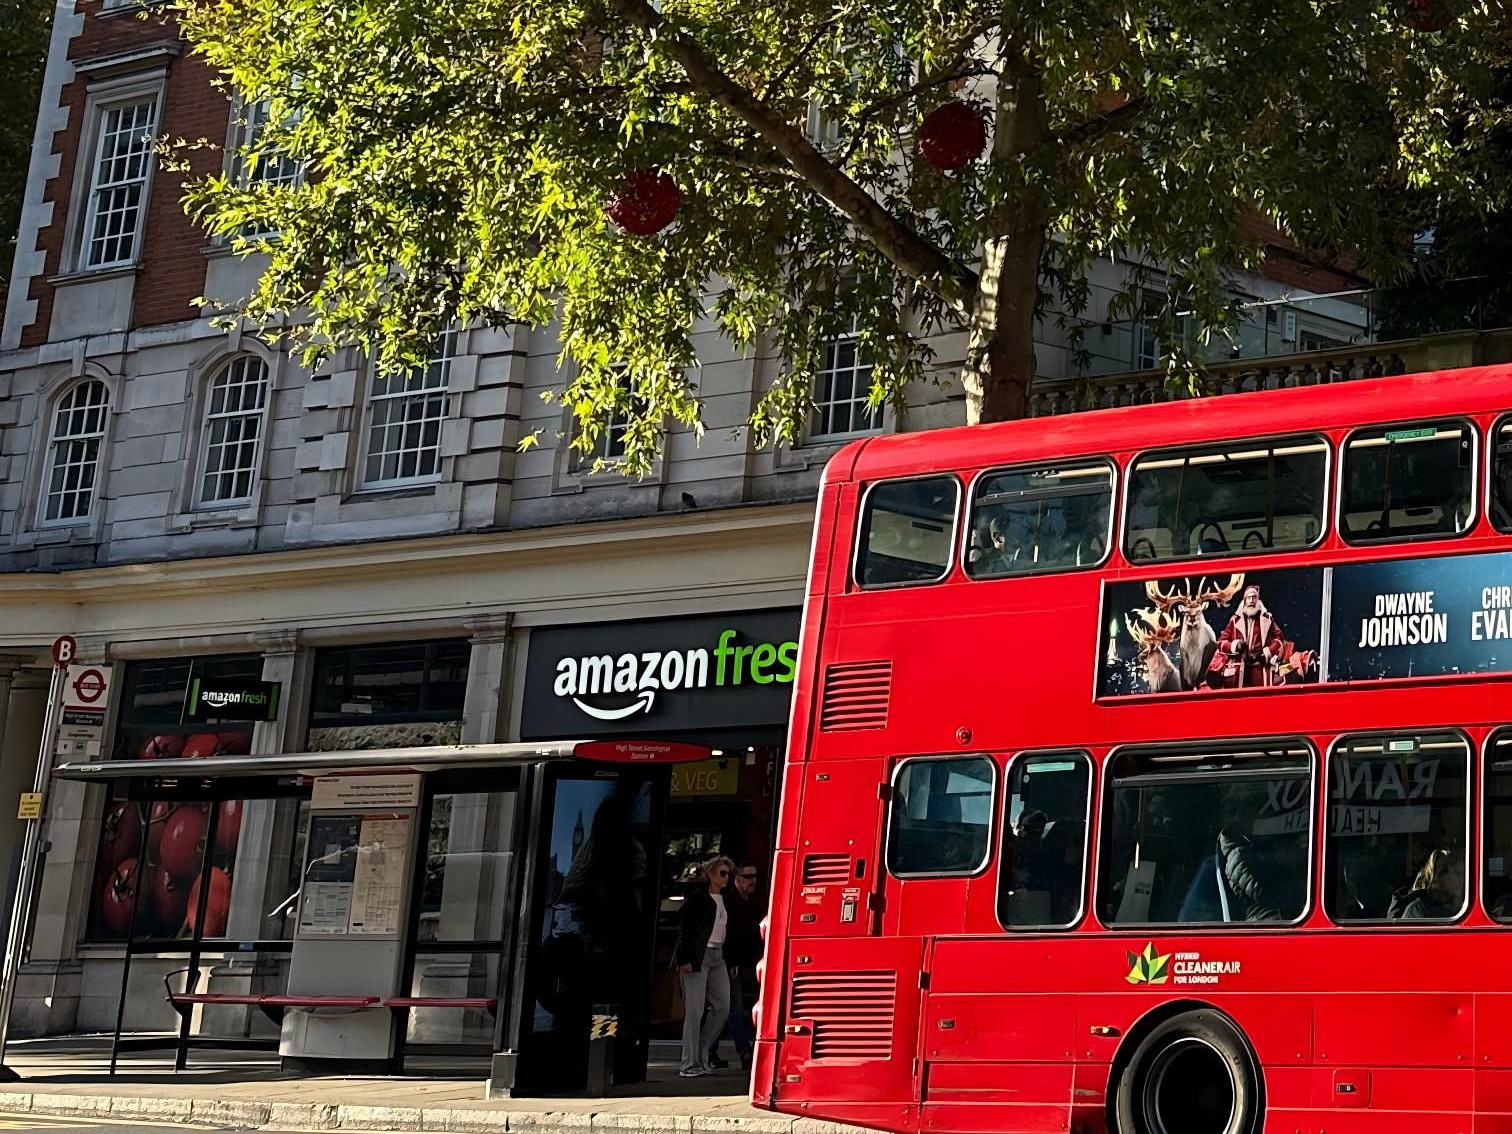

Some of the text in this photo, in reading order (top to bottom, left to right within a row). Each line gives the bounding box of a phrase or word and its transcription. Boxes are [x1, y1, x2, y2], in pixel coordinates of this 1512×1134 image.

[1374, 590, 1435, 617] DWAYNE
[1358, 613, 1448, 648] JOHNSON
[58, 640, 72, 662] B
[553, 648, 709, 697] amazon
[201, 689, 267, 706] amazon fresh
[685, 770, 718, 792] VEG
[1174, 975, 1218, 984] FOR LONDON
